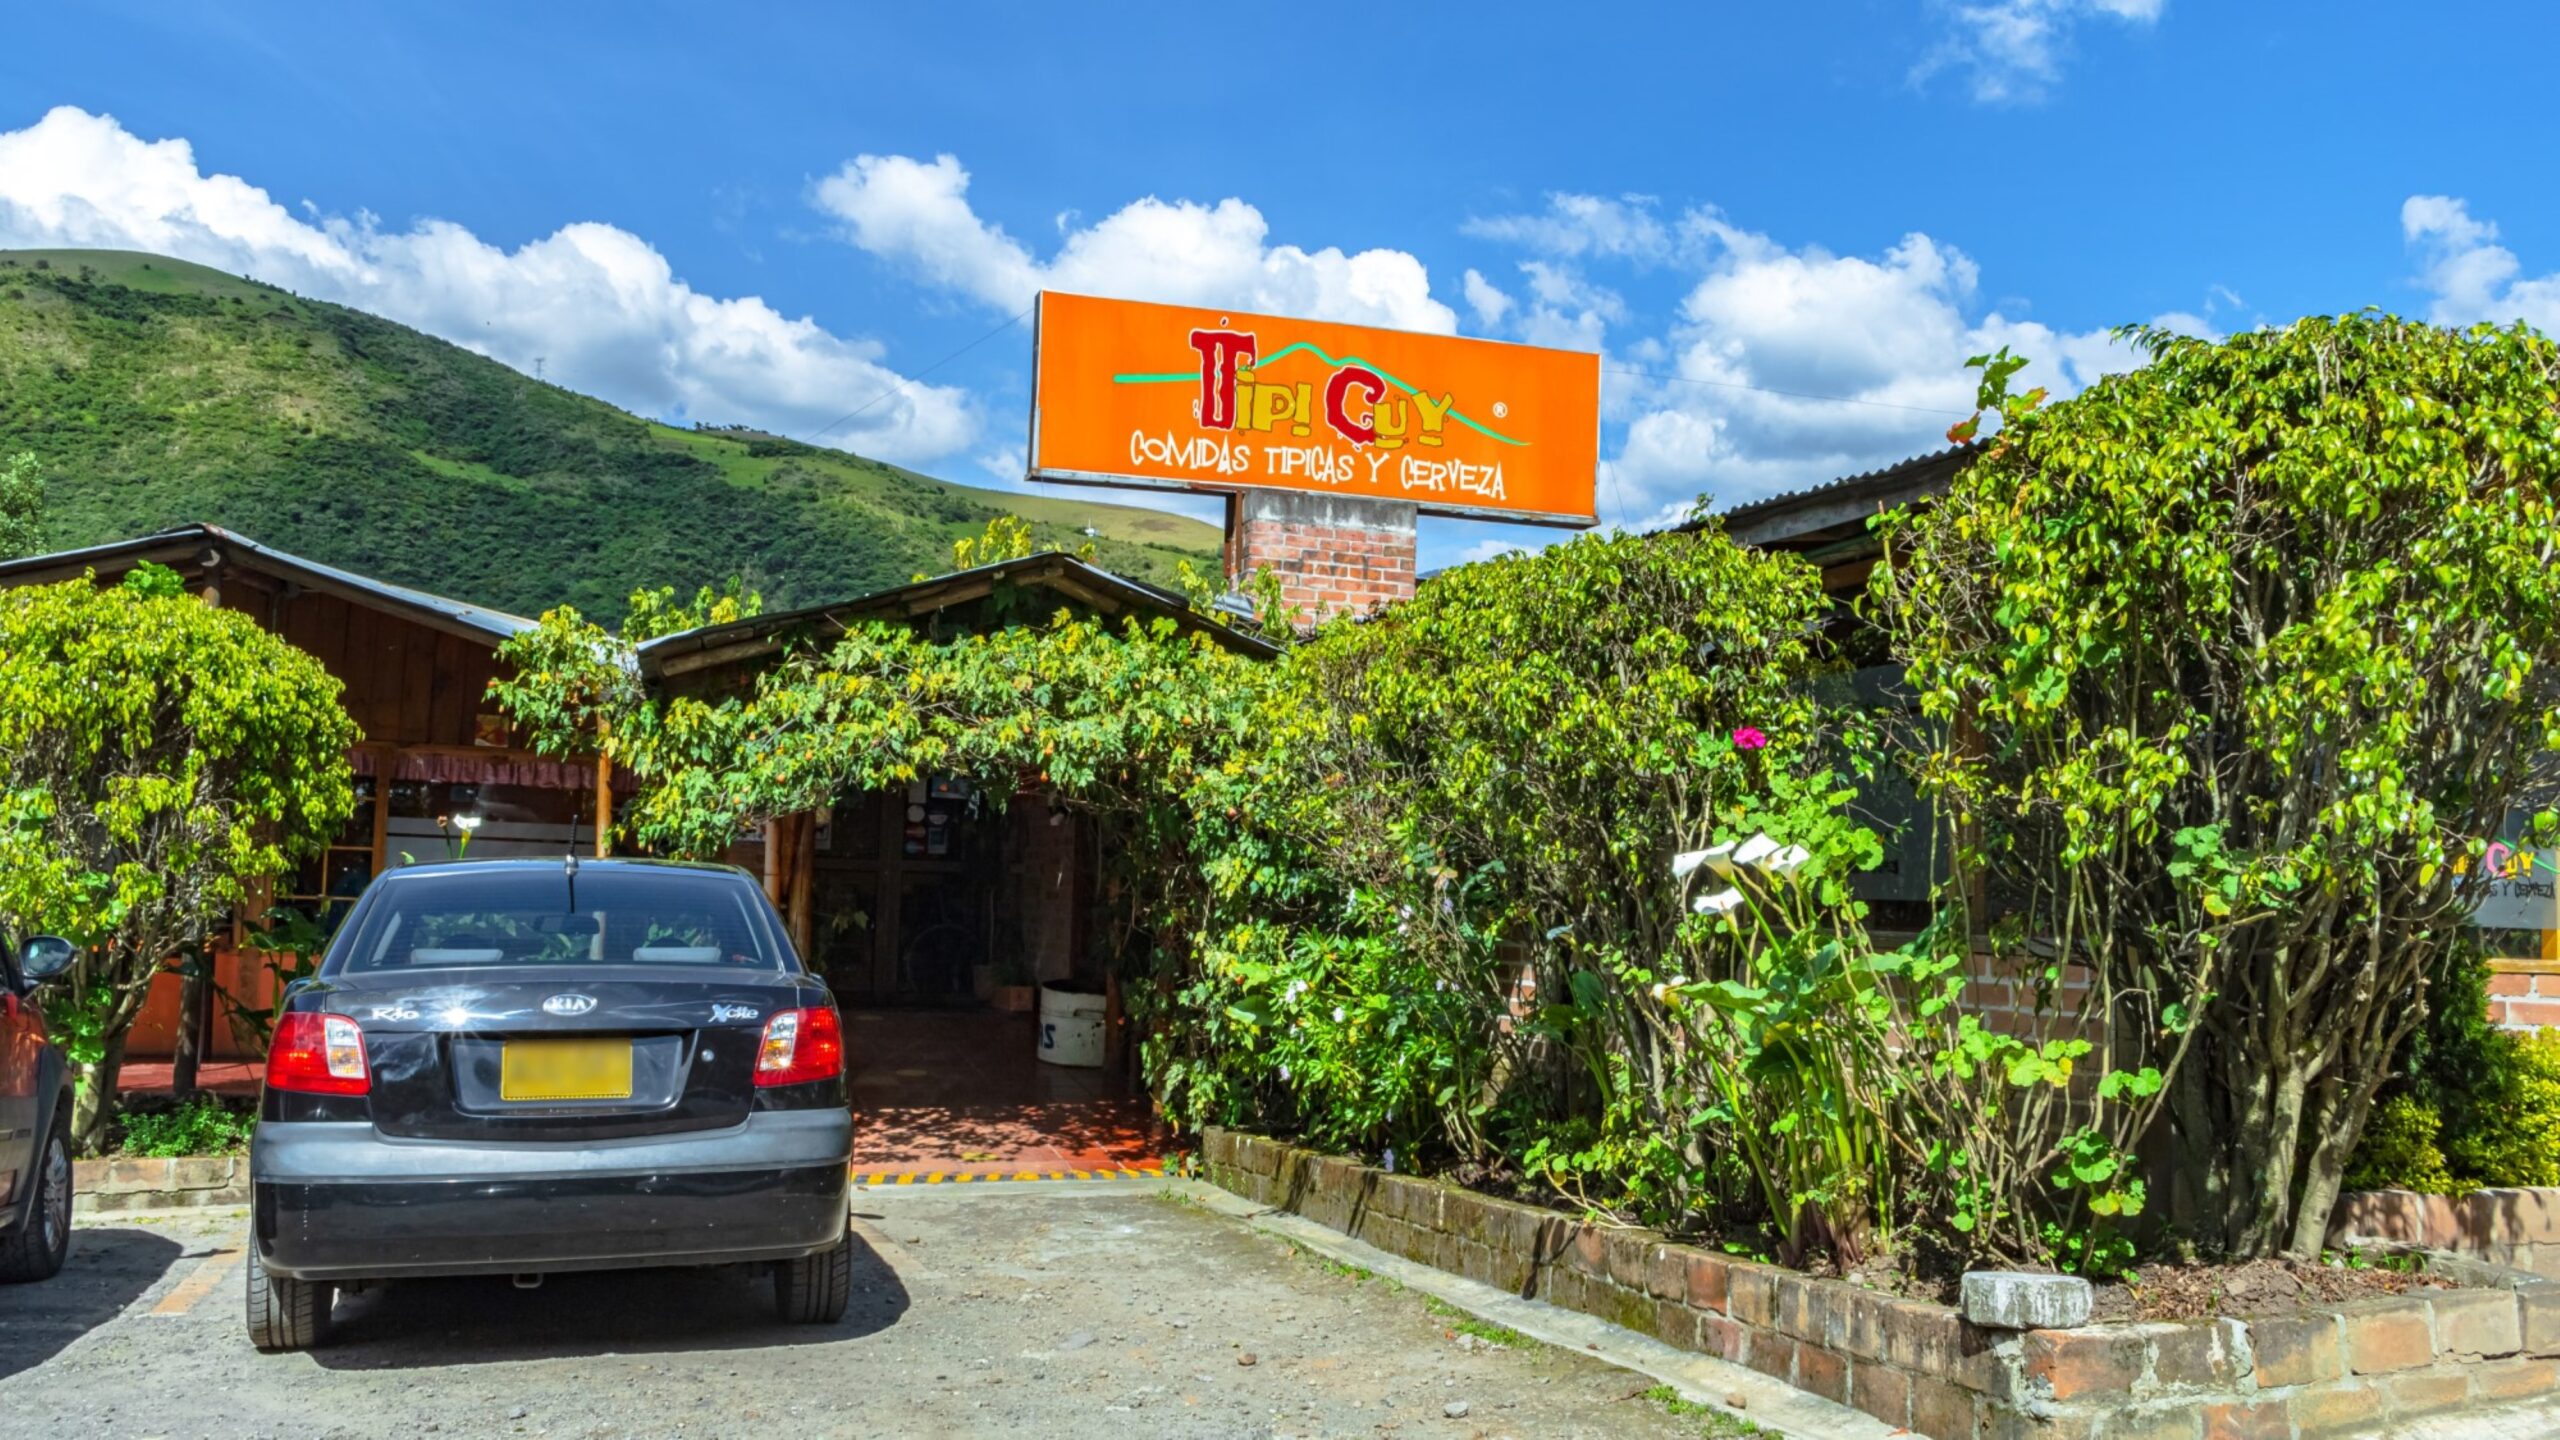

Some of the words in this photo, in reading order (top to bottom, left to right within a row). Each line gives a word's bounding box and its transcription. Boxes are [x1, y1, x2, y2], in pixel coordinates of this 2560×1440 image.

[1130, 430, 1251, 474] COMIDAS
[1263, 445, 1356, 485] TIPICAS
[1364, 453, 1390, 482] Y
[1400, 455, 1507, 500] CERVEZA
[547, 996, 589, 1011] KIA
